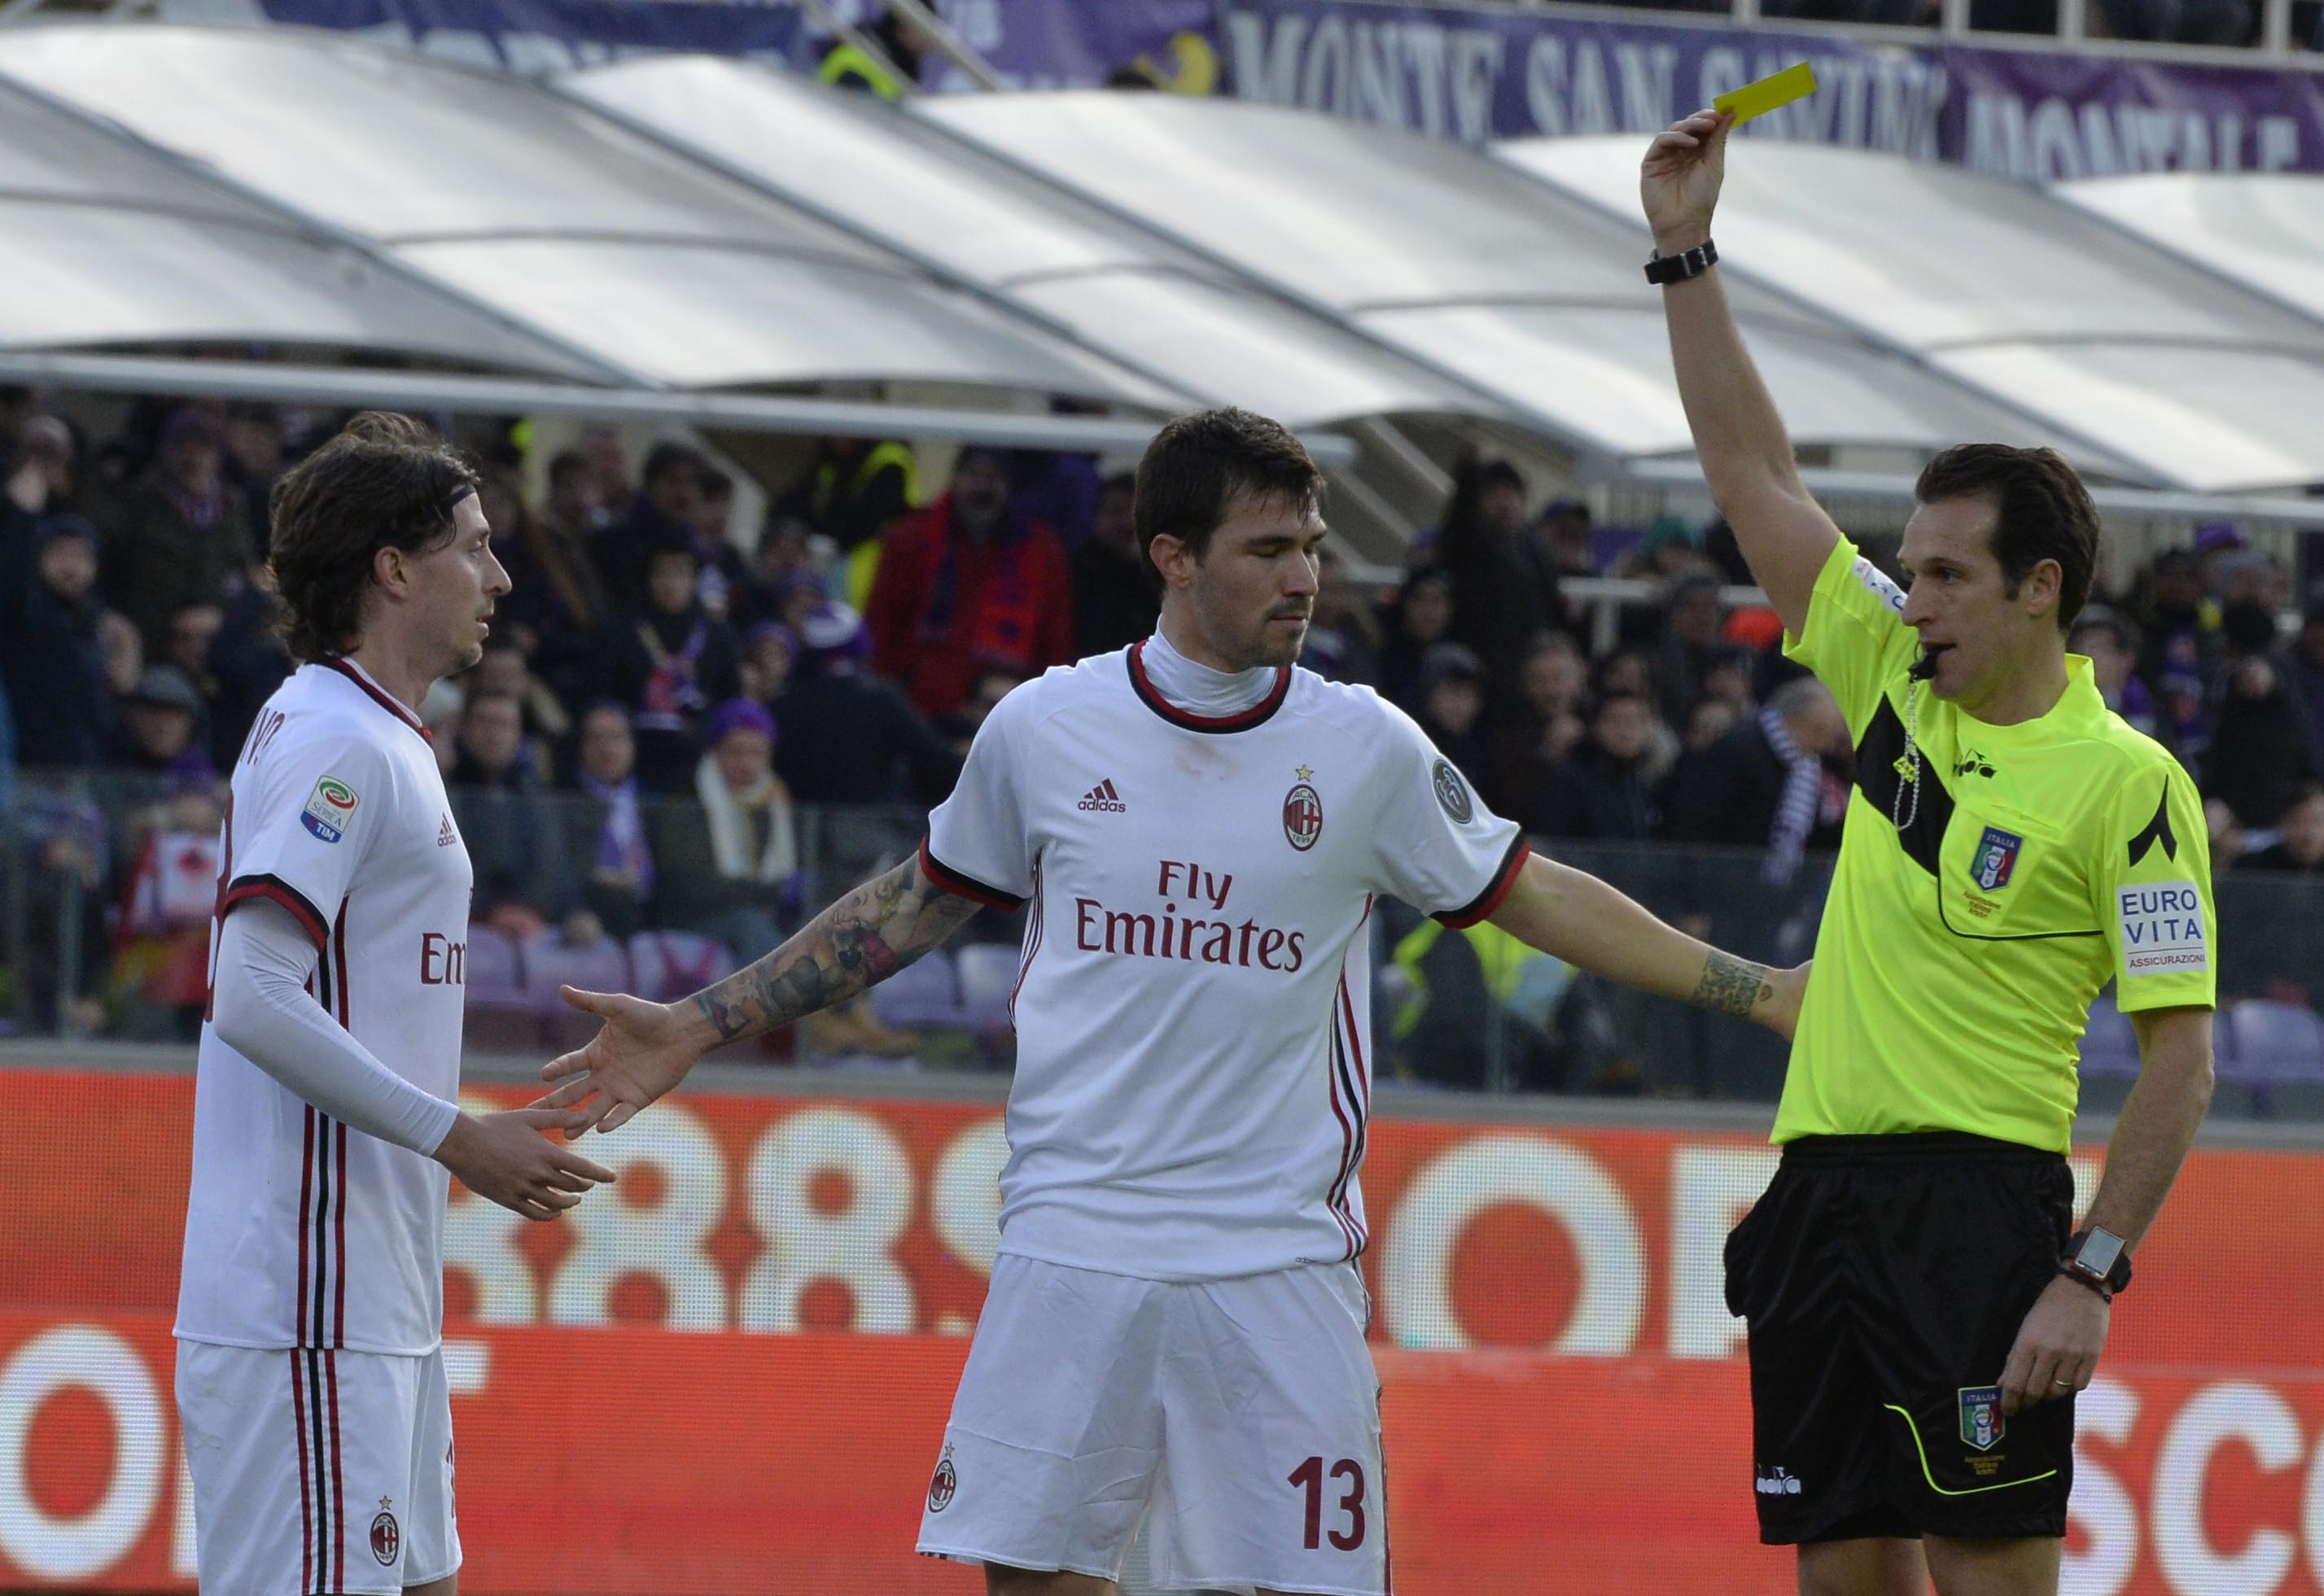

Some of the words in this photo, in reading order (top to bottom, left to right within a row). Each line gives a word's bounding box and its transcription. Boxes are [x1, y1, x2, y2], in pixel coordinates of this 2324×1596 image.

[1228, 11, 1503, 145] MONTE
[1526, 34, 1678, 136] SAN
[1078, 798, 1126, 812] adidas
[317, 822, 335, 841] TIM
[1987, 833, 2015, 848] ITALIA
[1158, 860, 1232, 910] Fly
[2121, 889, 2197, 916] EURO
[1074, 898, 1305, 973] Emirates
[2125, 918, 2202, 944] VITA
[2129, 954, 2205, 969] ASSICURAZIONI
[1967, 1393, 1997, 1402] ITALIA
[1287, 1456, 1366, 1552] 13
